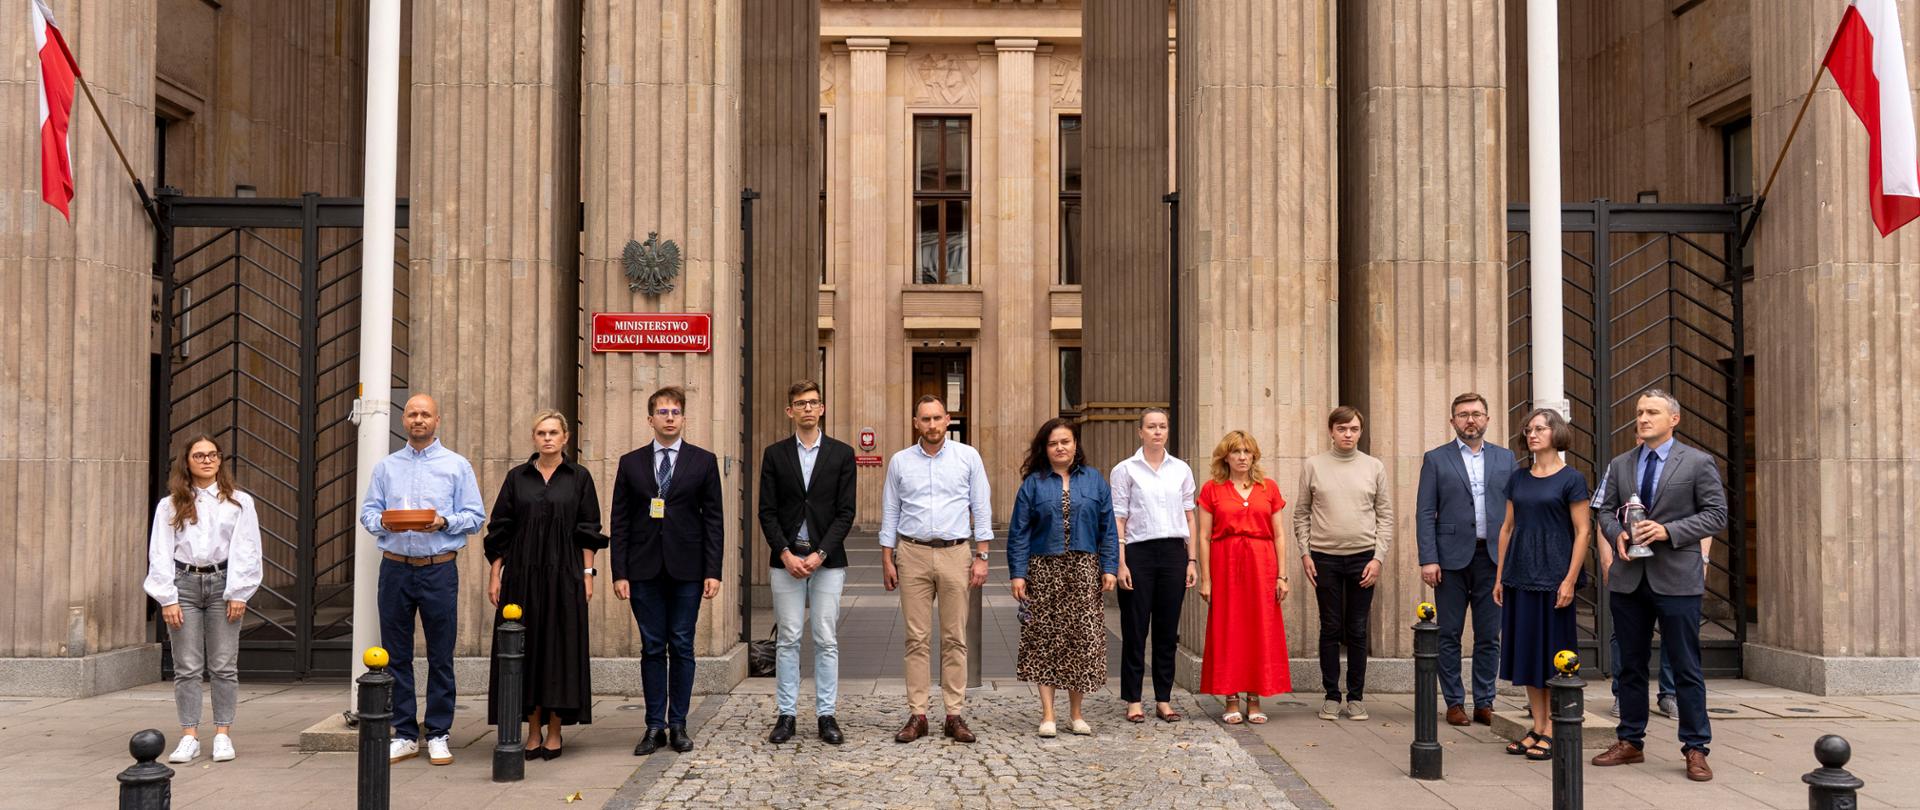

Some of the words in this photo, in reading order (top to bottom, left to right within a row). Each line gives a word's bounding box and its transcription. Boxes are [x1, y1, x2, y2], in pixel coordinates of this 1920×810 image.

[614, 321, 689, 331] MINISTERSTWO
[596, 334, 643, 346] EDUKACJI
[646, 334, 707, 346] NARODOWEJ
